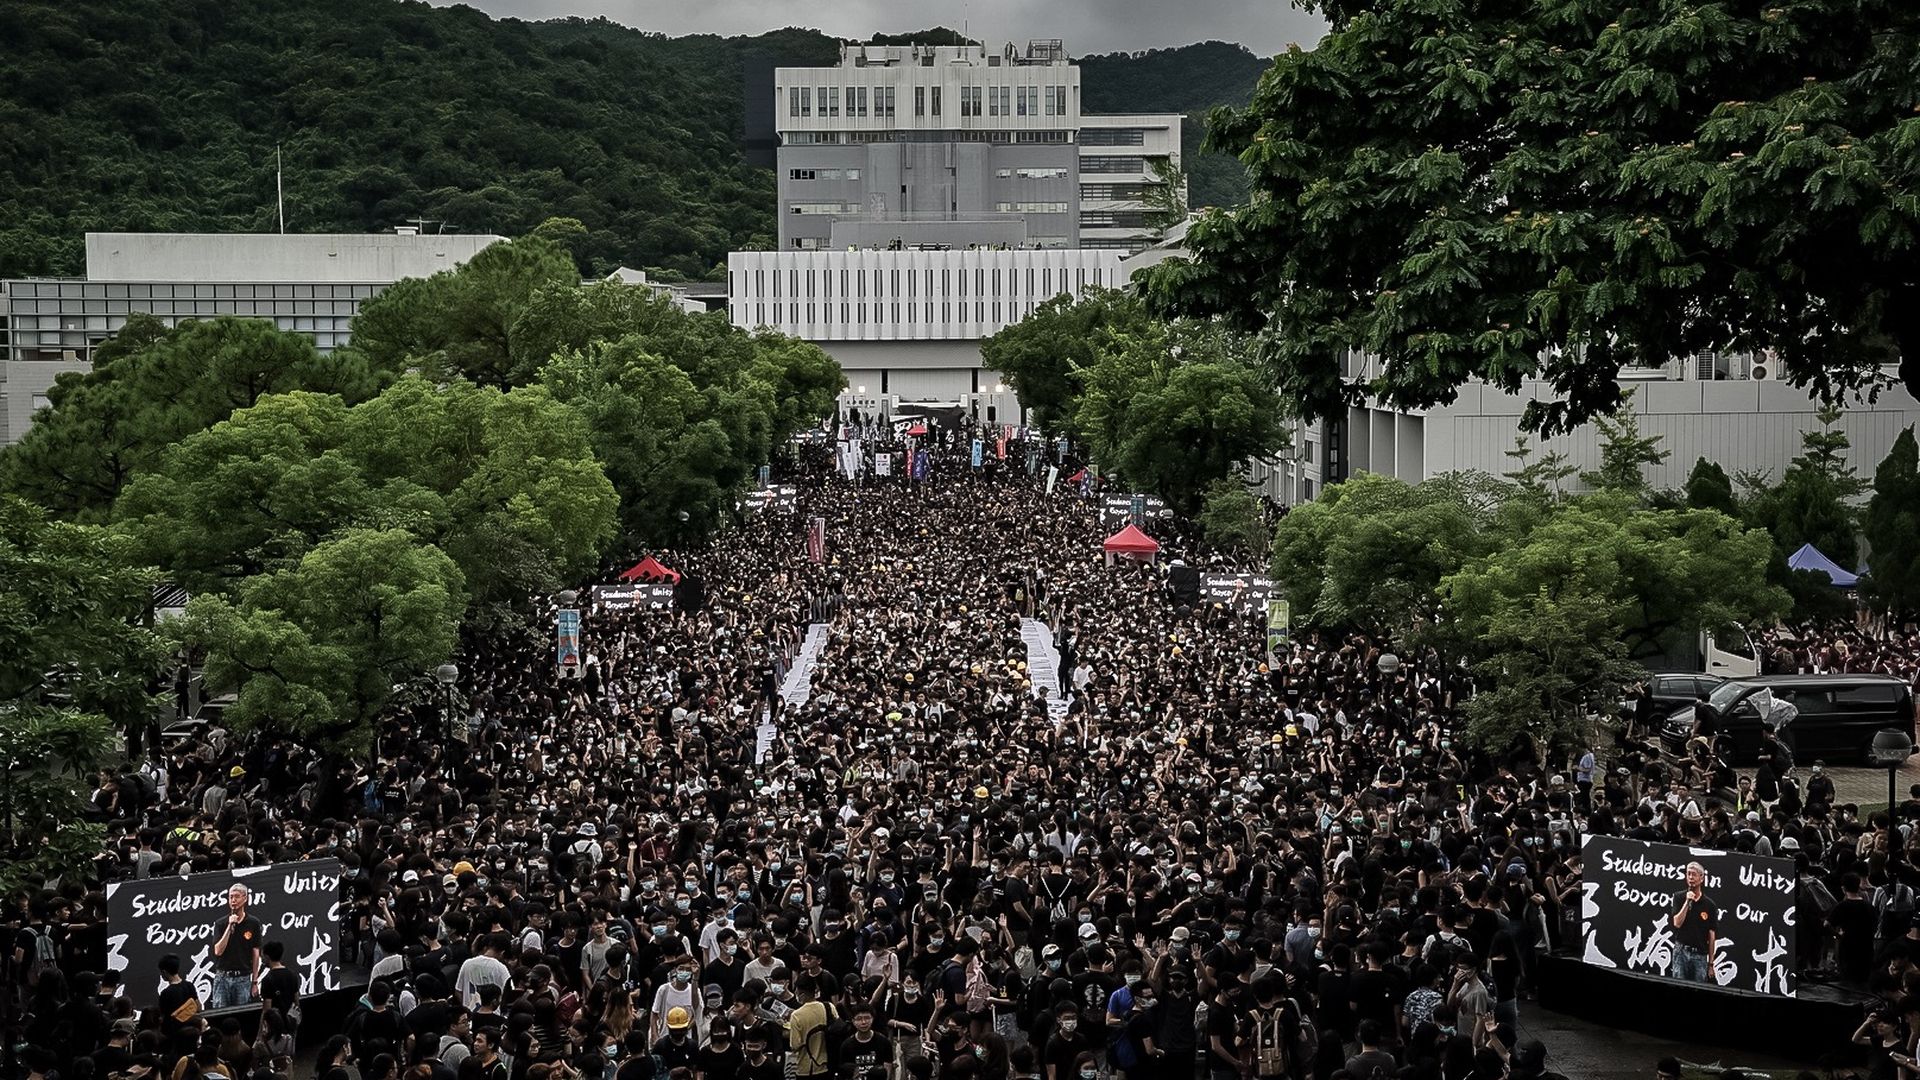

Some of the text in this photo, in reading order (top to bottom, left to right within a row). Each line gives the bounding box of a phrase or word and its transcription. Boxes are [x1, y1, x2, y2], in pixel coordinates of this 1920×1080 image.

[1602, 850, 1796, 894] Students in Unity
[132, 871, 340, 918] Students in Unity
[280, 911, 314, 930] Our
[1735, 903, 1769, 924] Our
